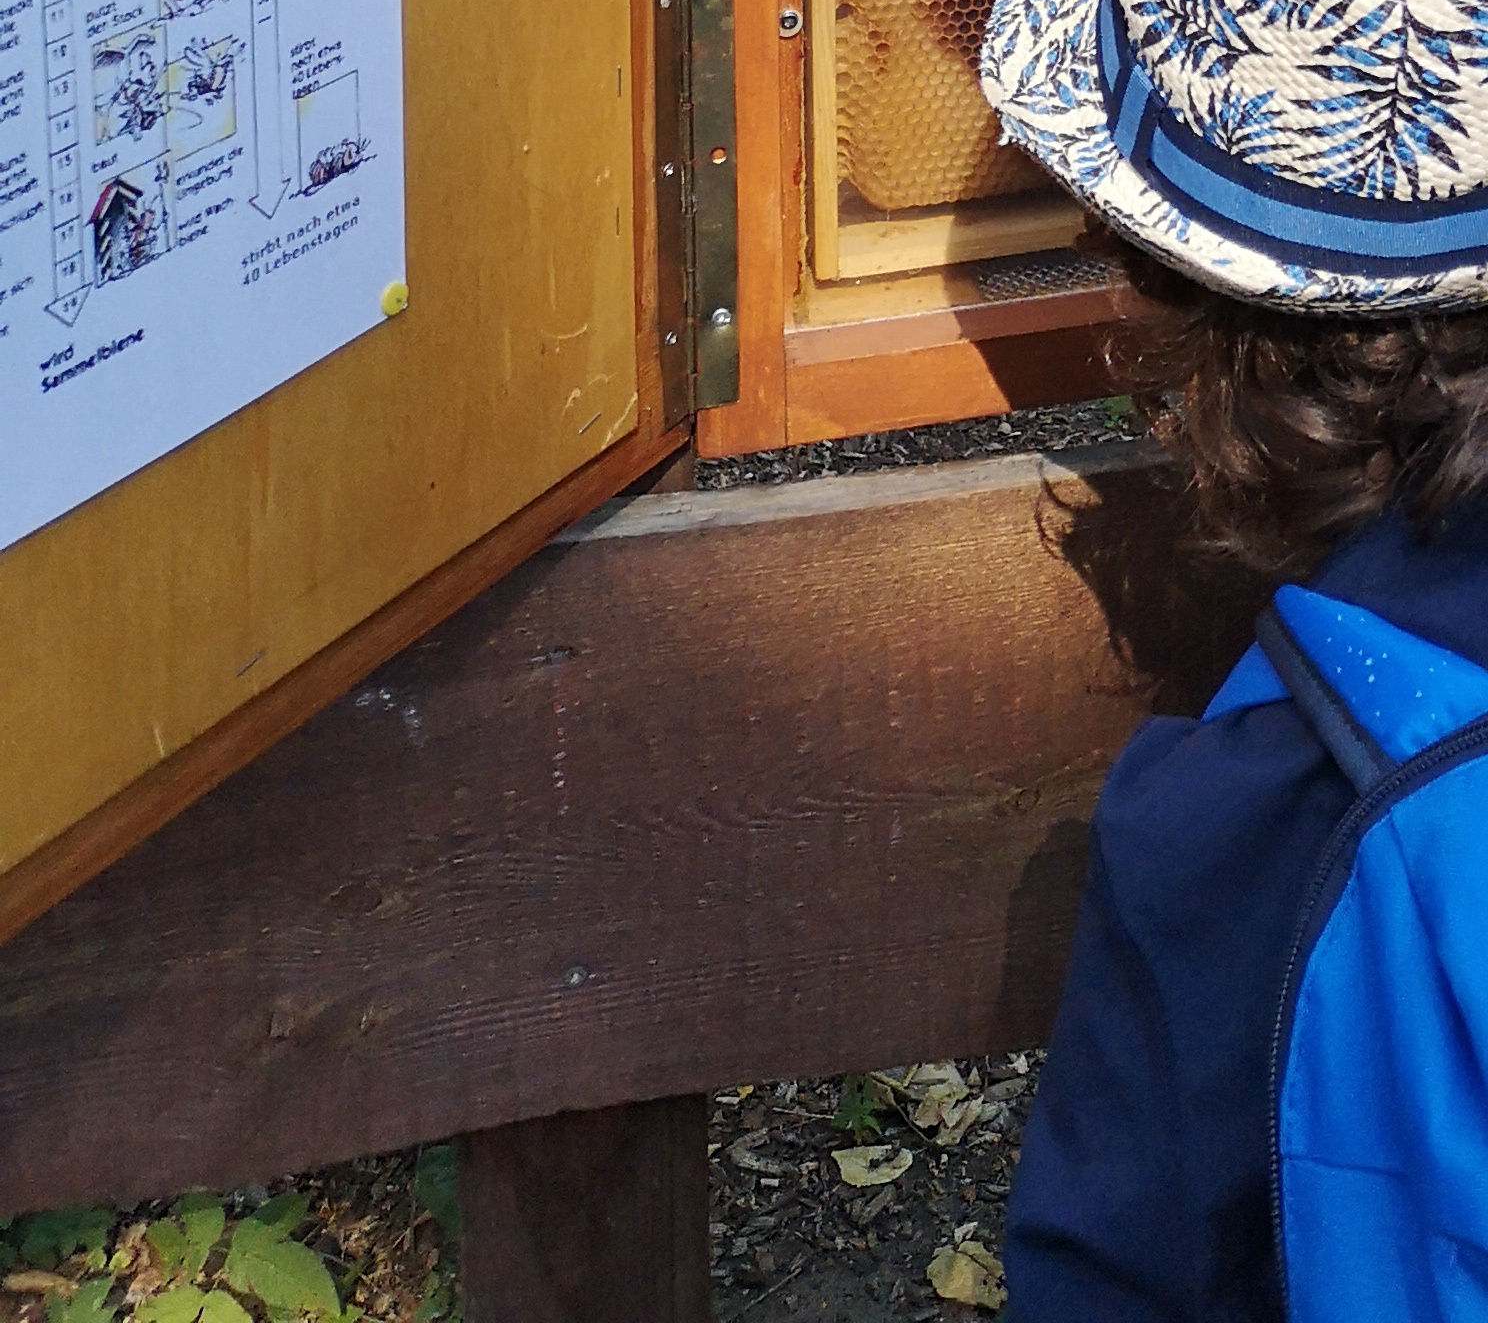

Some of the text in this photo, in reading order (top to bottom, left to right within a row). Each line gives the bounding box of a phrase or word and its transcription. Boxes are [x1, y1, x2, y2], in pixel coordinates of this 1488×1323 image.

[241, 196, 361, 269] stirbt nach etwa
[265, 213, 360, 275] Lebenstagen
